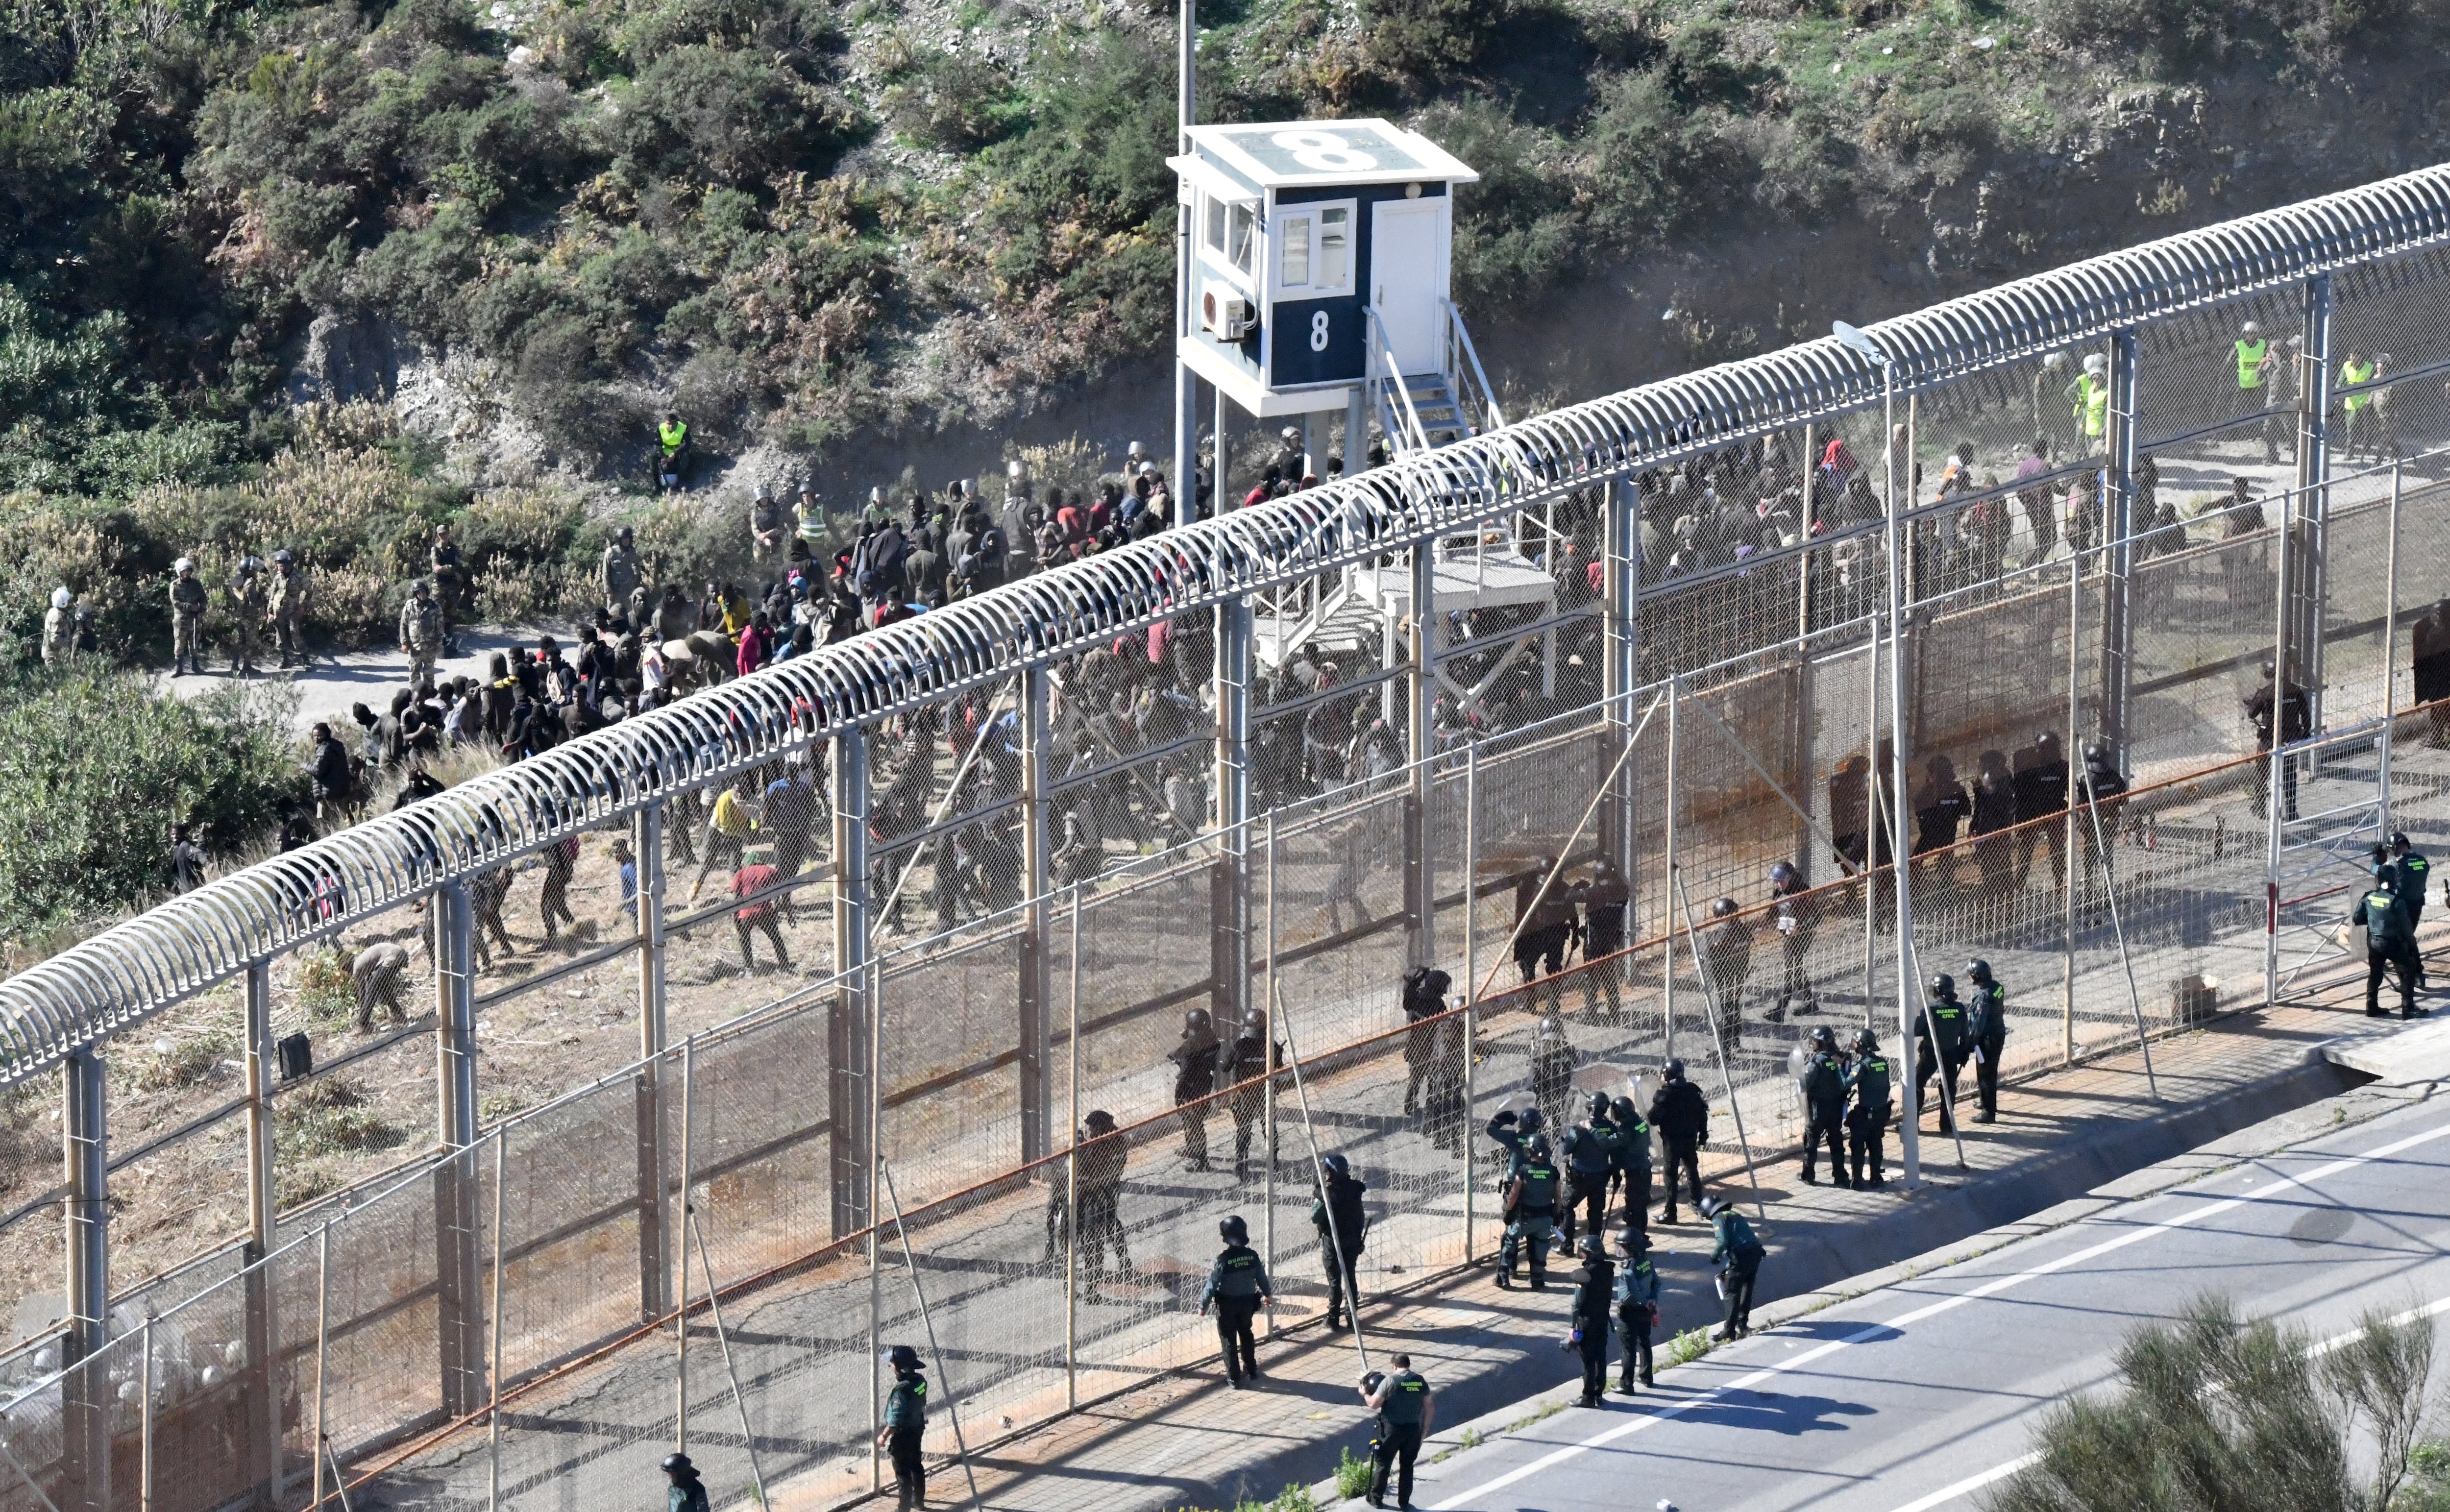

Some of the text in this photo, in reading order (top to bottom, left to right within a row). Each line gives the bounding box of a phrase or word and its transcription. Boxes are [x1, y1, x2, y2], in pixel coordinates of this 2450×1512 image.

[1271, 130, 1377, 172] 8
[1310, 310, 1329, 352] 8
[1227, 1256, 1254, 1265] GUARDIA
